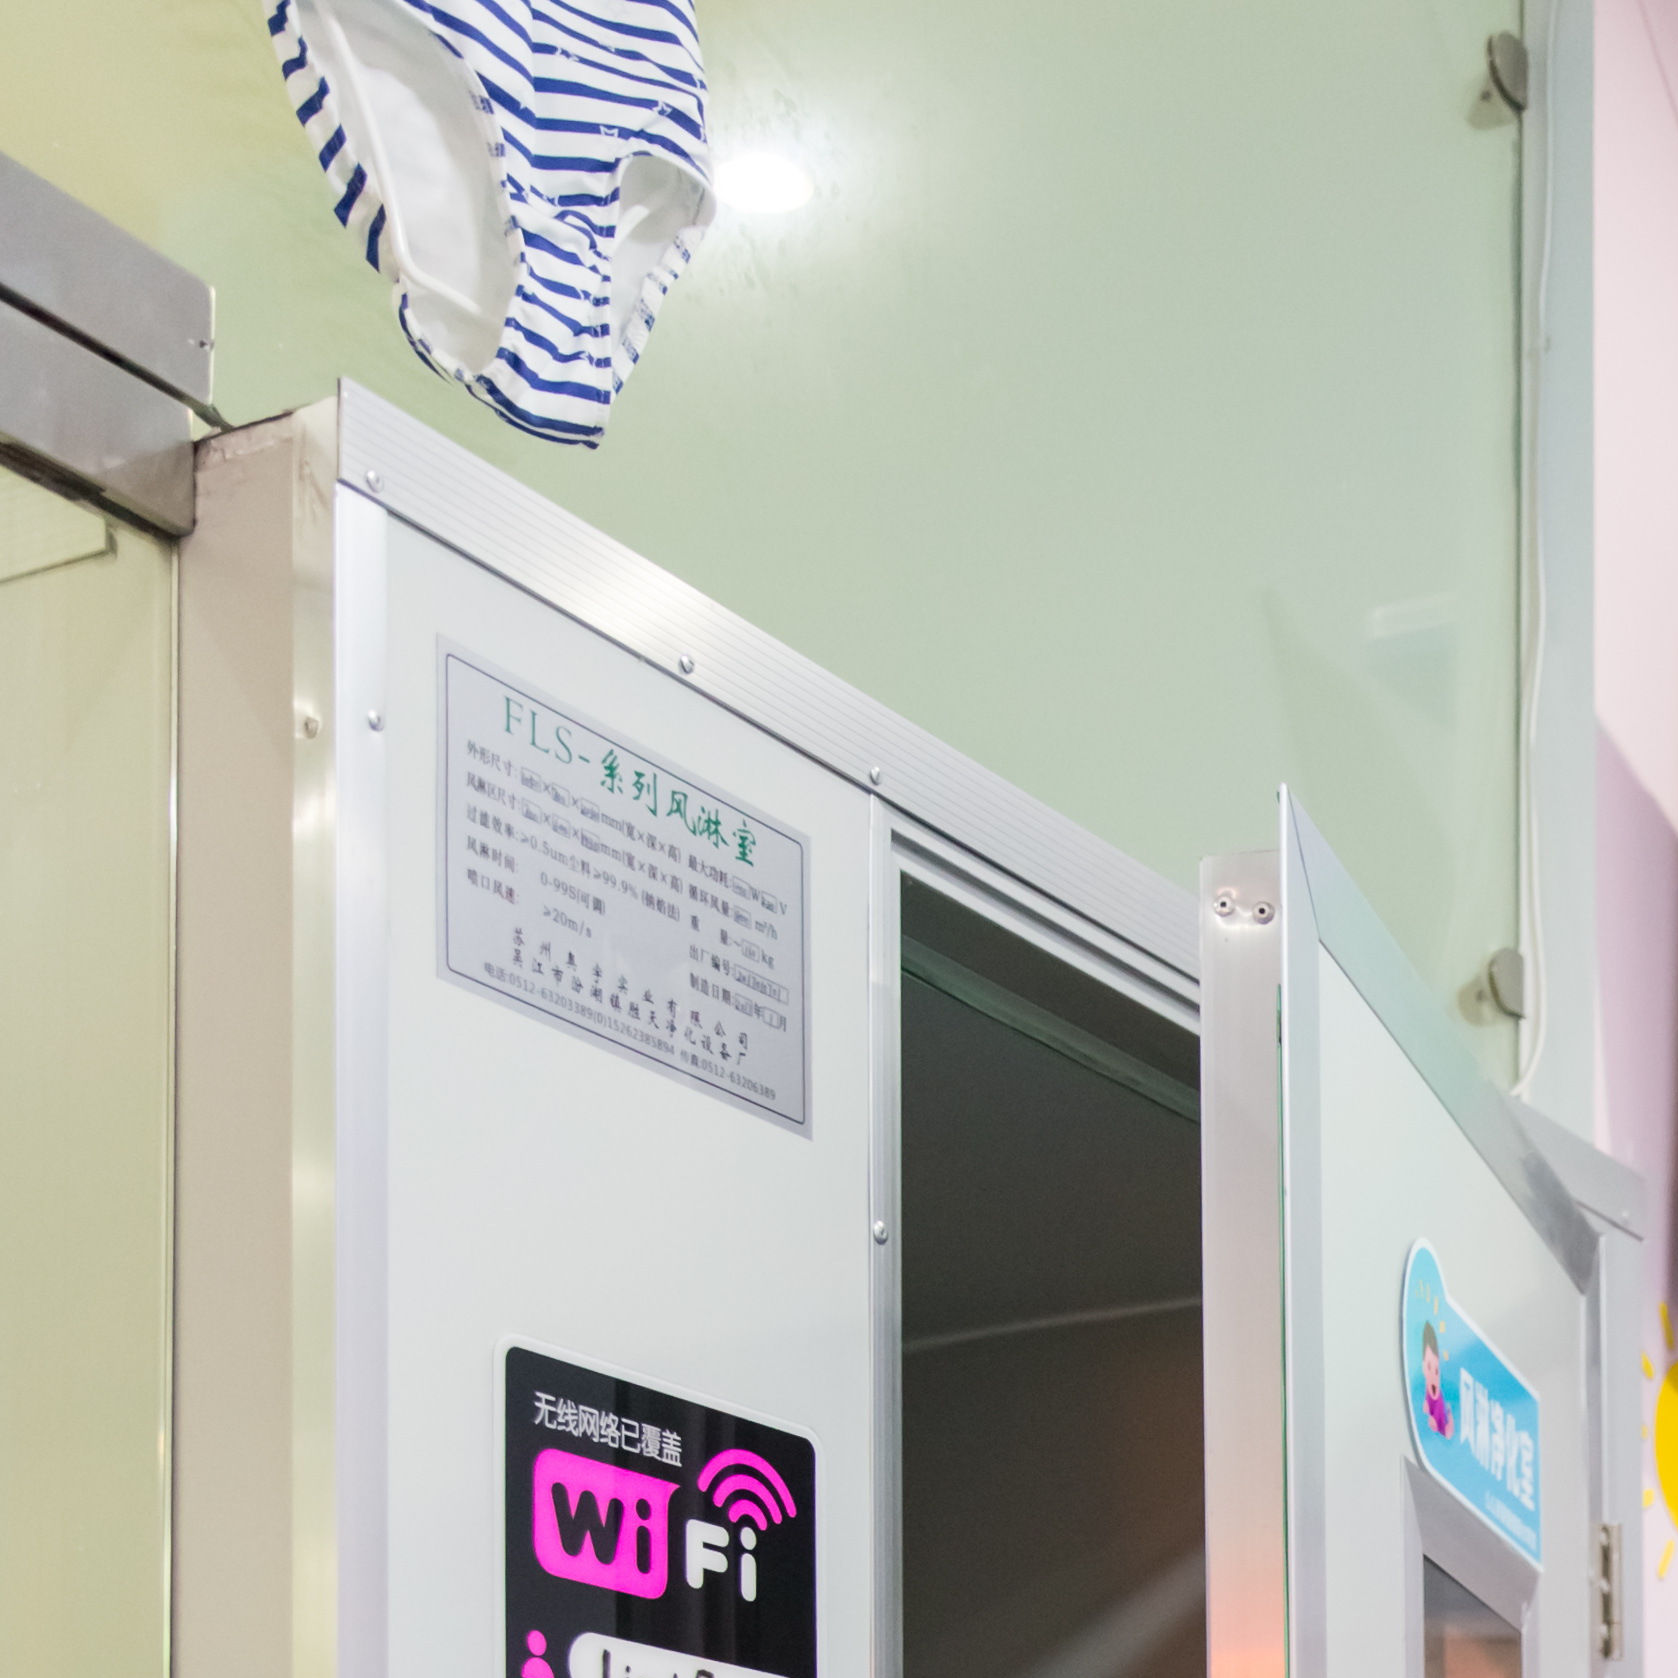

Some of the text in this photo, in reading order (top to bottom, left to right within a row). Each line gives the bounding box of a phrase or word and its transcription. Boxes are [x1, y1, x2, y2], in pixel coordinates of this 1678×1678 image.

[533, 1390, 682, 1467] 无线网络已覆盖
[551, 1481, 757, 1602] Wi Fi
